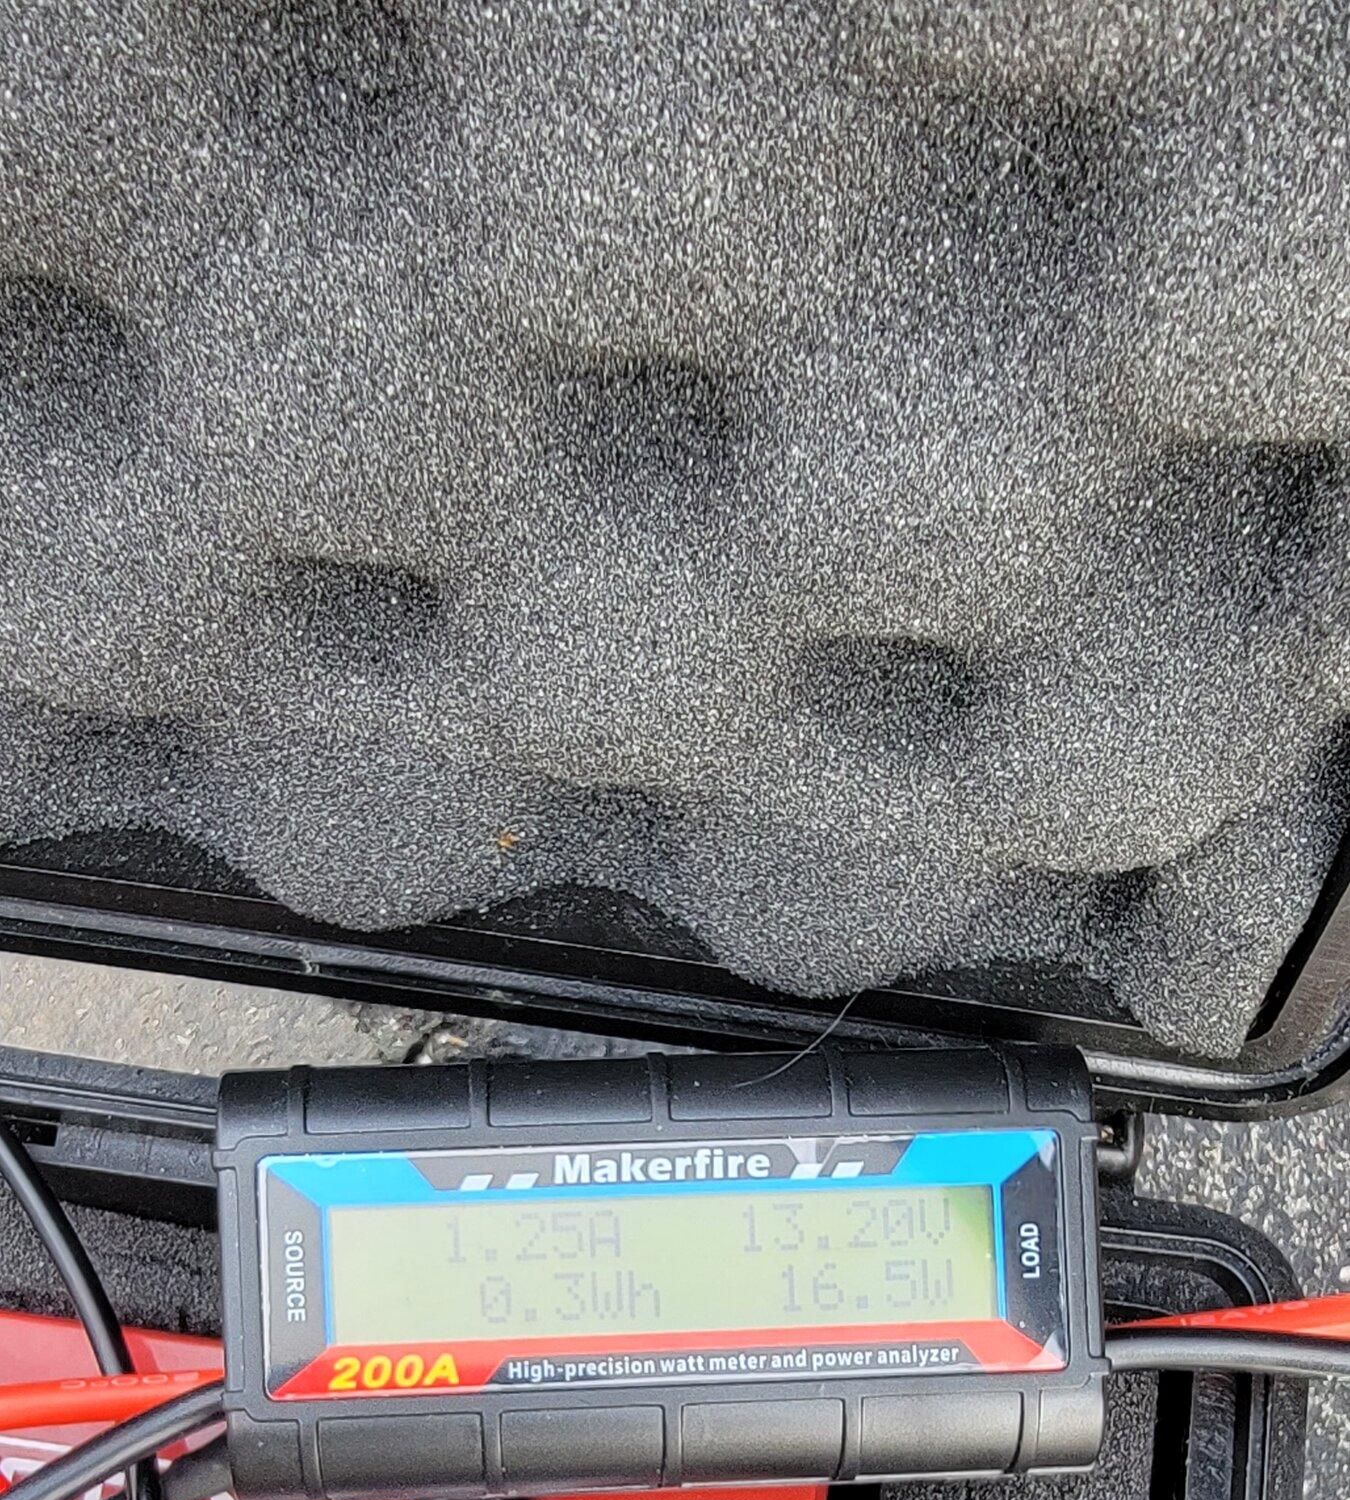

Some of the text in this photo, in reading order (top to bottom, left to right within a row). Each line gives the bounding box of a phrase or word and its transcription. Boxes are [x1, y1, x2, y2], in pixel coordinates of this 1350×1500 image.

[554, 1148, 770, 1185] Makerfire
[447, 1210, 622, 1264] 1.25A
[742, 1198, 951, 1253] 13.20V
[1019, 1222, 1041, 1279] LOAD
[284, 1230, 307, 1323] SOURCE
[480, 1270, 661, 1324] 0.3Wh
[783, 1257, 954, 1312] 16.5W
[328, 1353, 460, 1391] 200A
[507, 1345, 960, 1382] High-precision watt meter and power analyzer
